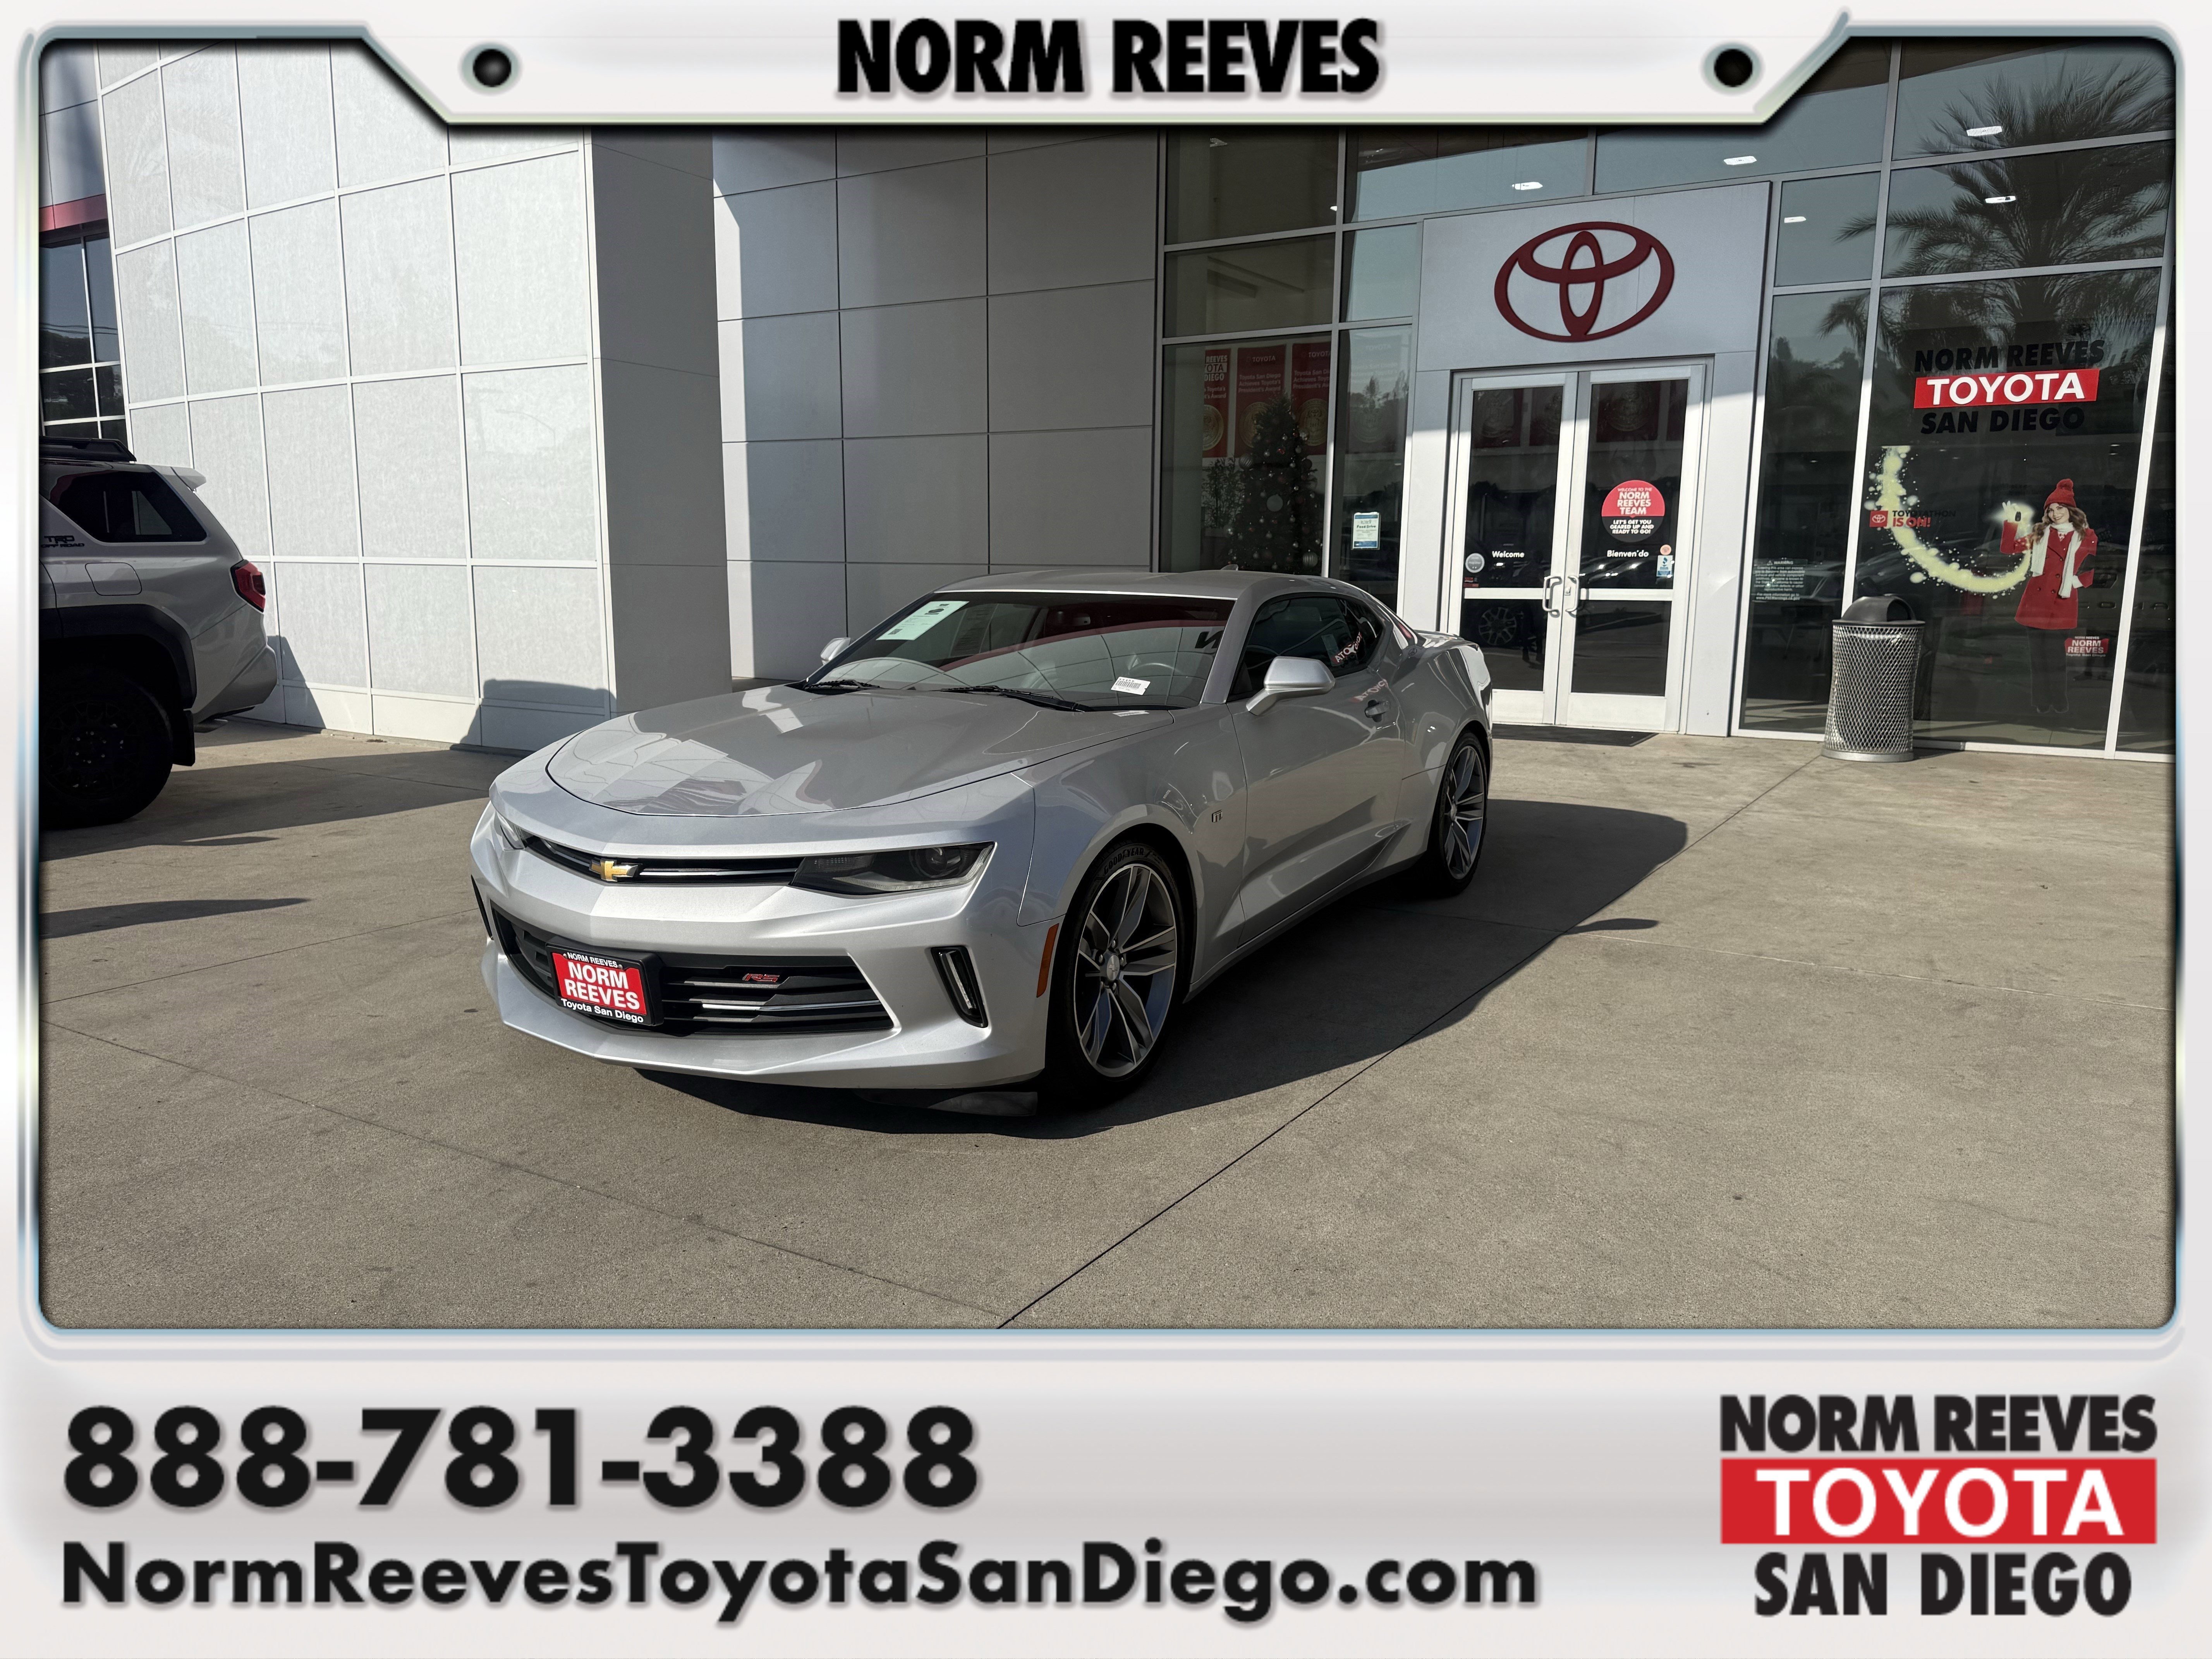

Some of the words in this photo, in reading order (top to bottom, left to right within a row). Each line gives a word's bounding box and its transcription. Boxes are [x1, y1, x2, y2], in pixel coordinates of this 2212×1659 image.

[1915, 346, 1998, 372] NORM
[2007, 340, 2105, 367] REEVES
[1927, 372, 2085, 405] TOYOTA
[1921, 411, 1978, 434] SAN
[1990, 407, 2085, 432] DIEGO
[1620, 507, 1647, 515] TEAM
[1893, 517, 1904, 527] IS
[1906, 517, 1931, 527] ON!
[44, 535, 75, 544] TRD
[567, 952, 588, 962] NORM
[589, 956, 618, 968] REEVES
[568, 961, 629, 989] NORM
[742, 973, 780, 982] RS
[564, 979, 640, 1010] REEVES
[561, 998, 592, 1012] Toyota
[594, 1005, 613, 1017] San
[615, 1010, 644, 1023] Diego
